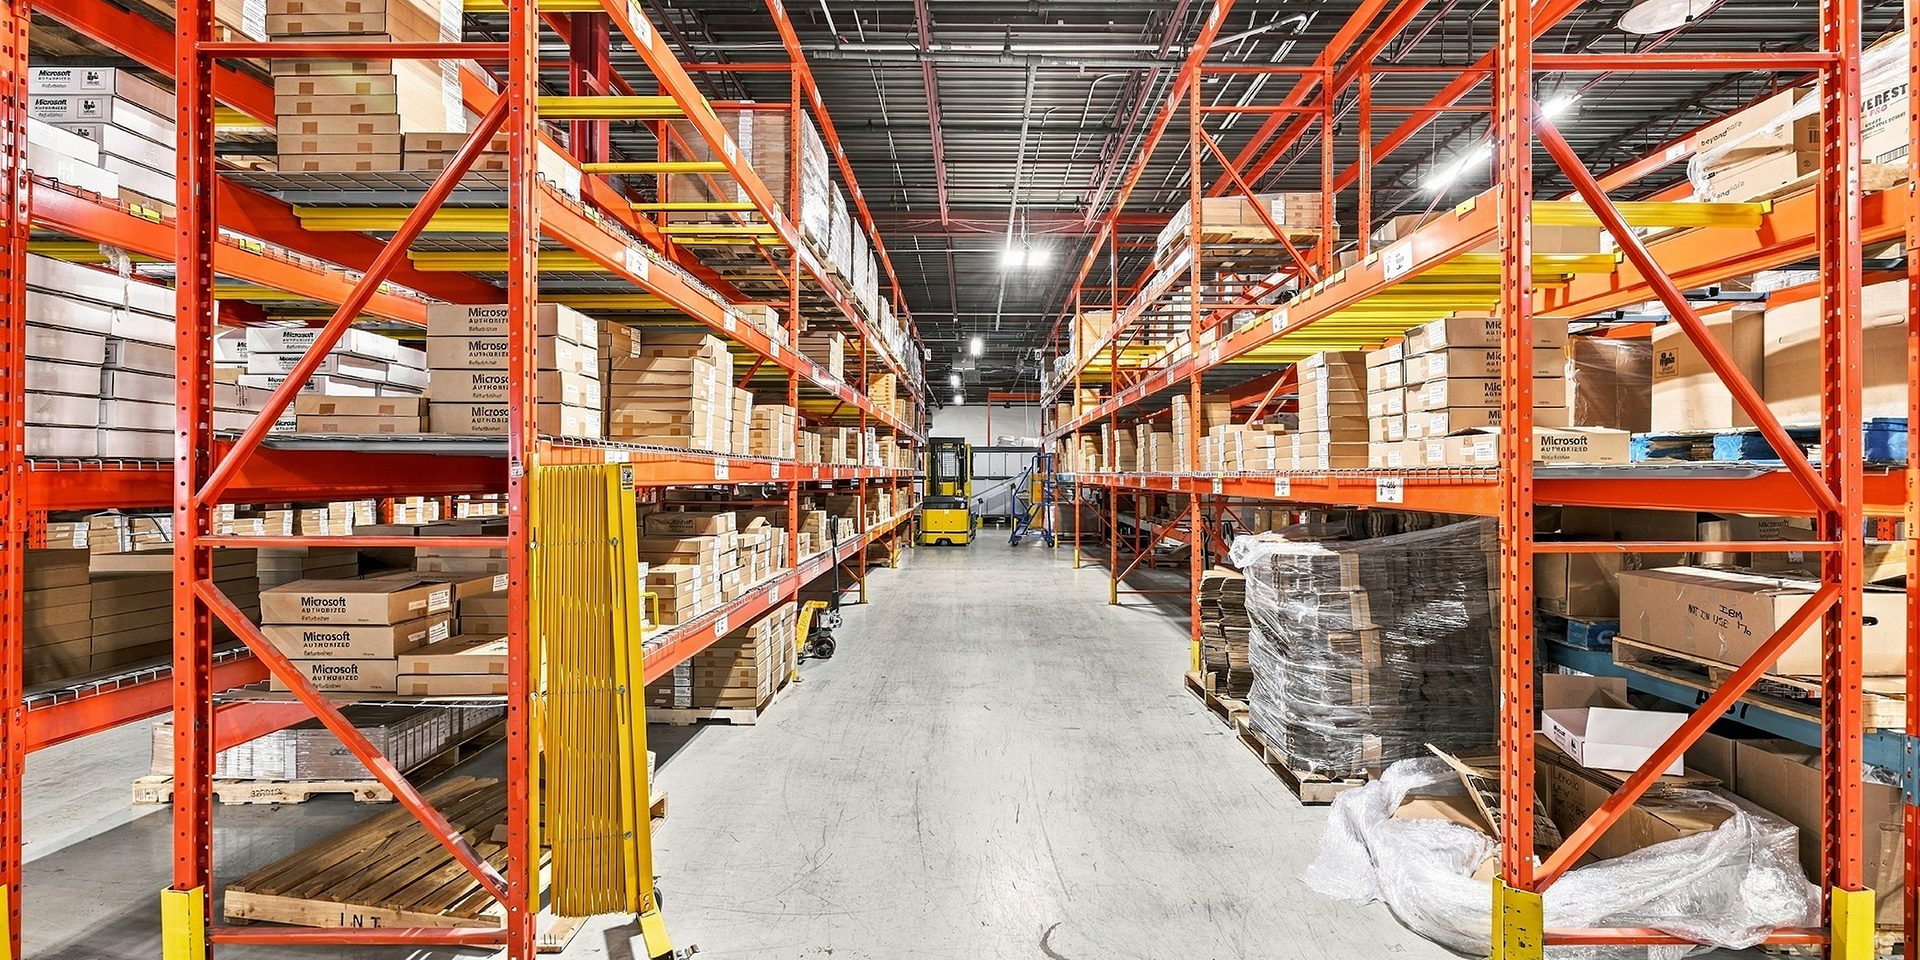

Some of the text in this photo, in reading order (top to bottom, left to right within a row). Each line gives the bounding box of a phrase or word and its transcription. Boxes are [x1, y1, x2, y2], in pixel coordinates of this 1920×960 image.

[1861, 83, 1908, 113] VEREST
[469, 308, 508, 317] Microso
[469, 341, 508, 350] Microso
[472, 374, 508, 384] Micros
[472, 407, 508, 416] Microso
[1541, 436, 1587, 445] Microsoft
[301, 596, 346, 606] Microsoft
[1719, 604, 1742, 620] IBM
[303, 631, 350, 641] Microsoft
[312, 664, 358, 674] Microsoft
[341, 912, 380, 928] INT
